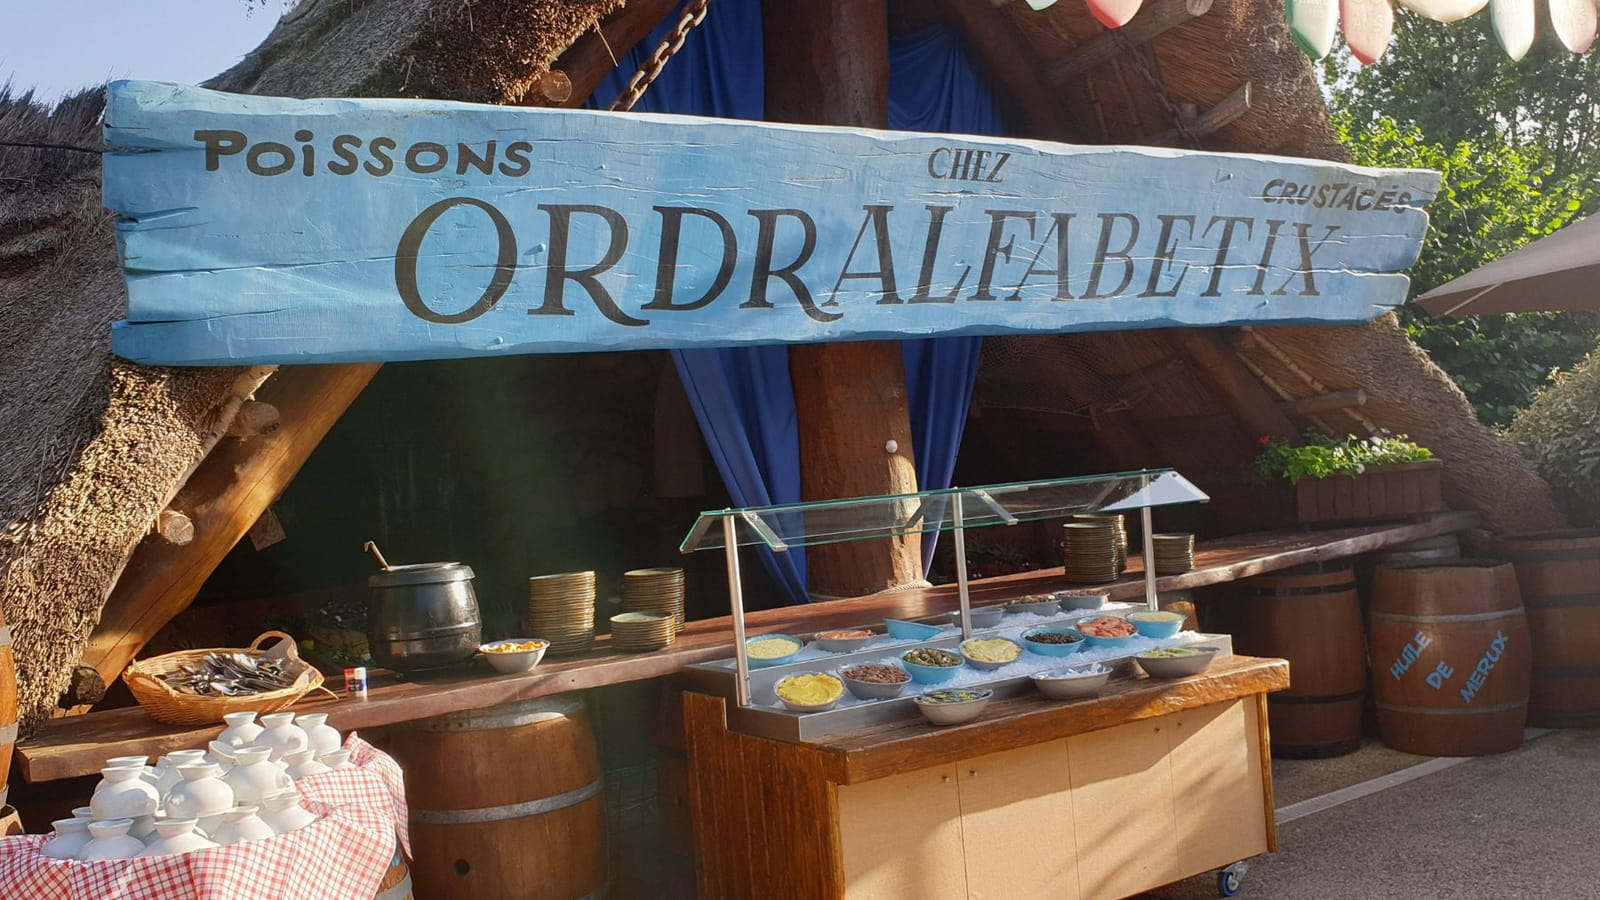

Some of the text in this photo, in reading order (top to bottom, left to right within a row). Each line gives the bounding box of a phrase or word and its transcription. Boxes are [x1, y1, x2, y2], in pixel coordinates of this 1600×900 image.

[194, 129, 533, 177] POiSSONS
[928, 147, 1011, 183] CHEZ
[1262, 179, 1412, 214] CRUSTACÉS
[394, 196, 1341, 326] ORDRALFABETIX
[1390, 629, 1432, 680] HUILE
[1425, 660, 1454, 690] DE
[1459, 629, 1508, 704] MERUX
